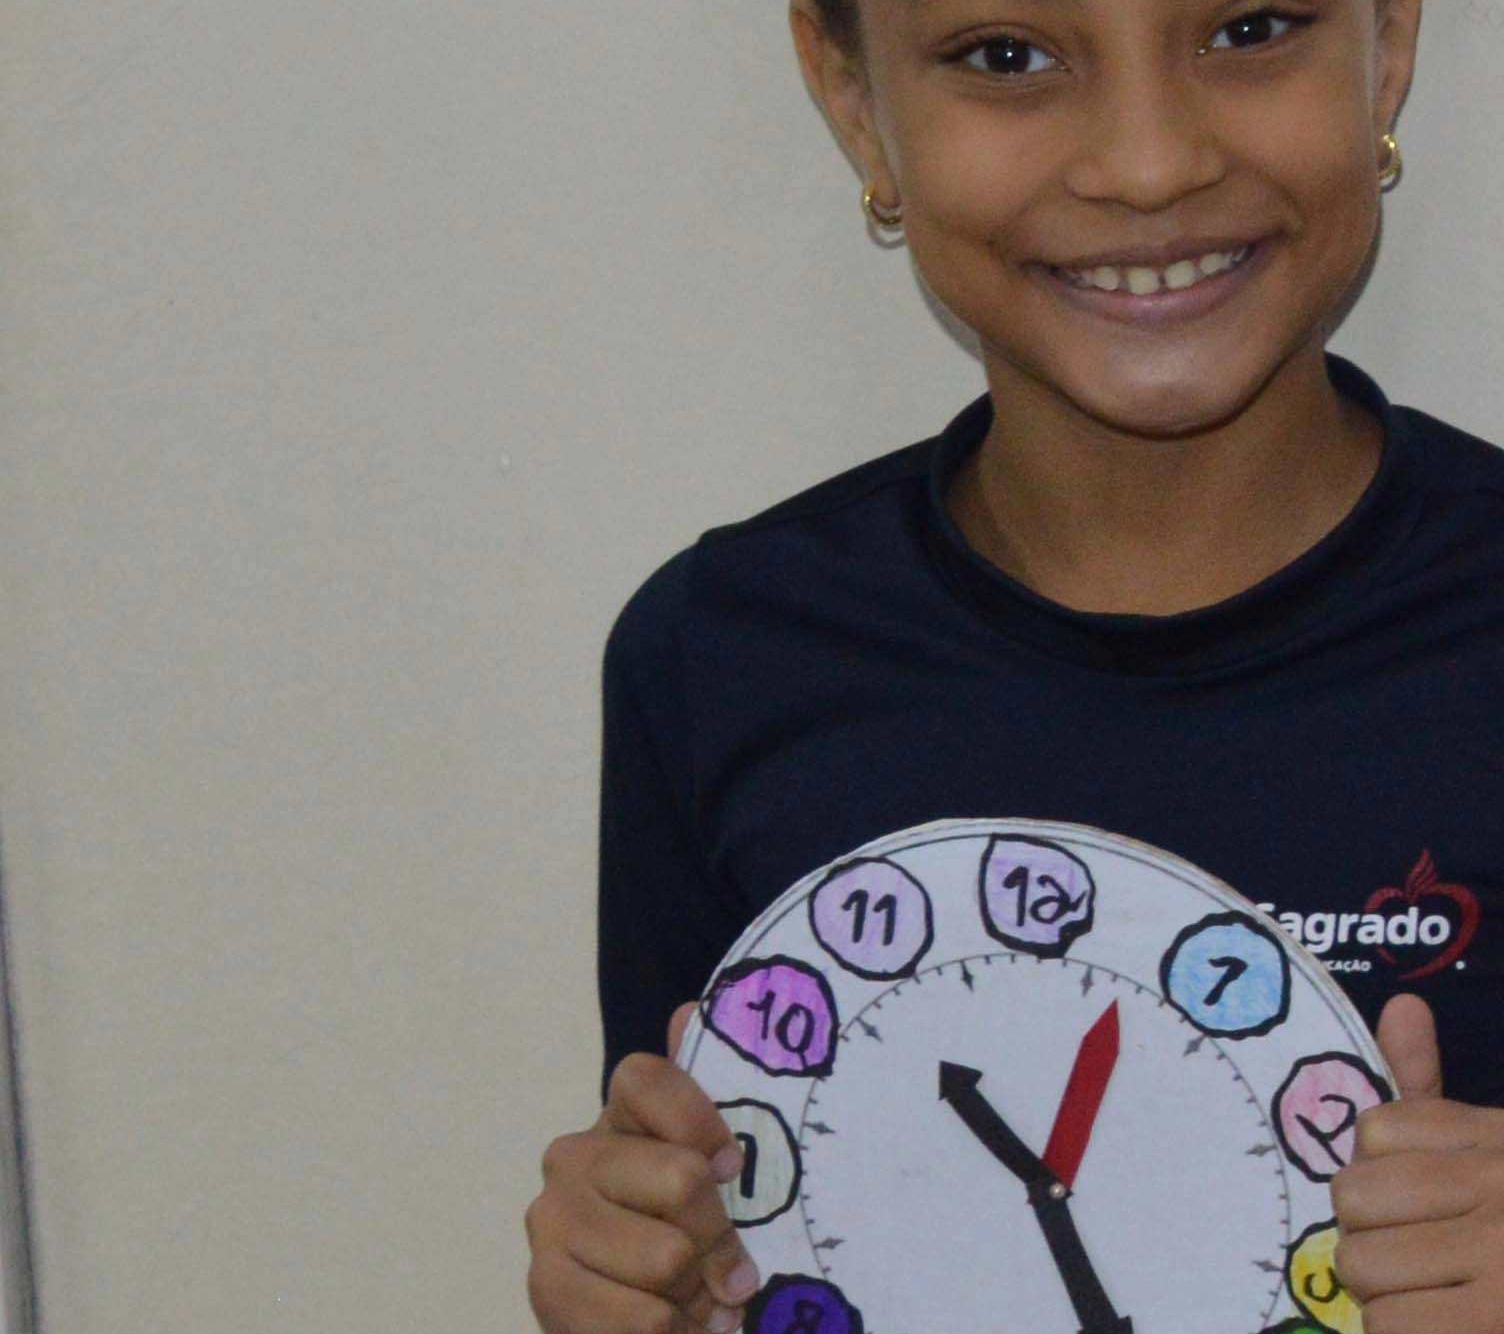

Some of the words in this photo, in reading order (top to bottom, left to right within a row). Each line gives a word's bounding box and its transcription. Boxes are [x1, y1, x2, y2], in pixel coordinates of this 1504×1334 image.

[841, 889, 898, 947] 11
[1003, 866, 1085, 924] 12
[1255, 902, 1450, 953] agrado
[1322, 959, 1372, 973] CAÇÃO
[746, 989, 815, 1054] 10
